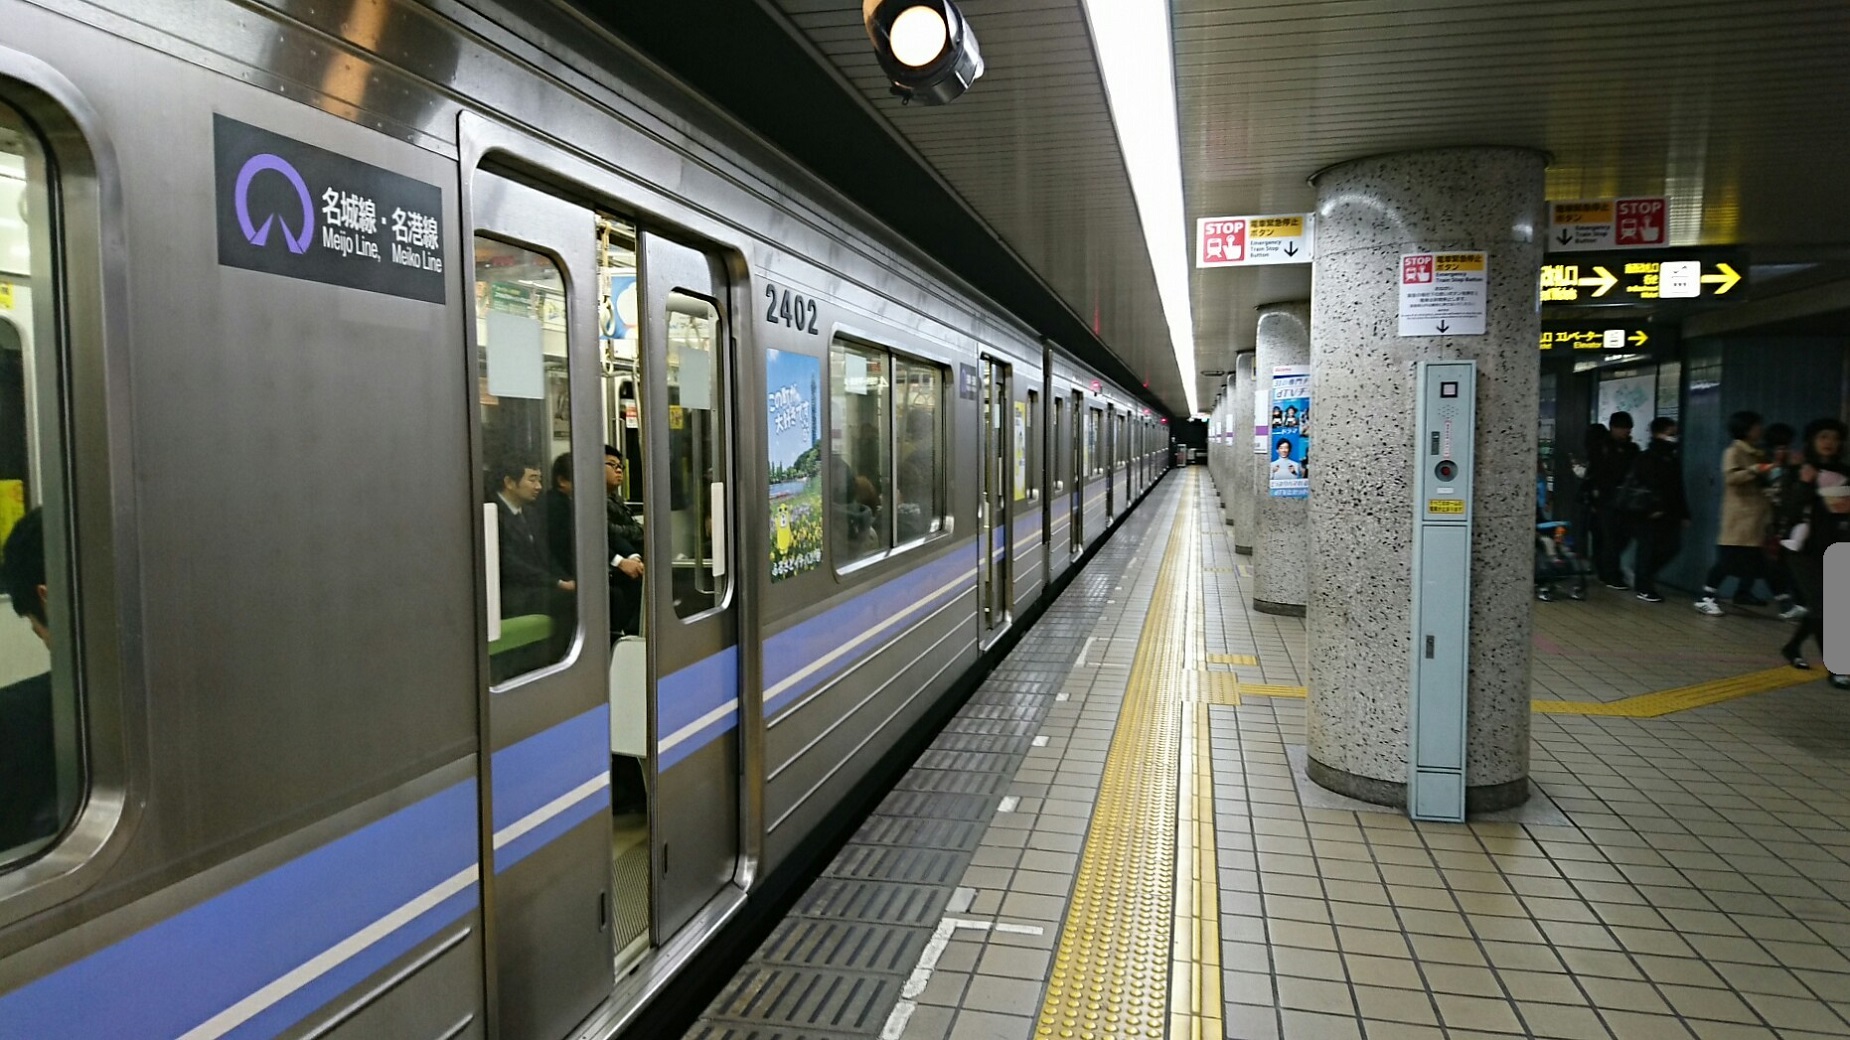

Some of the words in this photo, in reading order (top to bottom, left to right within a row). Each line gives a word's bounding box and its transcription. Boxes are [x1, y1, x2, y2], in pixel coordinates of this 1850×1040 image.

[1619, 201, 1662, 215] STOP
[1205, 222, 1244, 235] STOP
[1250, 229, 1275, 237] ボタン
[322, 226, 354, 257] Meijo
[356, 234, 381, 262] Line,
[392, 243, 421, 268] Meiko
[423, 250, 443, 273] Line
[1404, 257, 1432, 266] STOP
[765, 283, 819, 336] 2402
[1555, 331, 1603, 342] エレベーター
